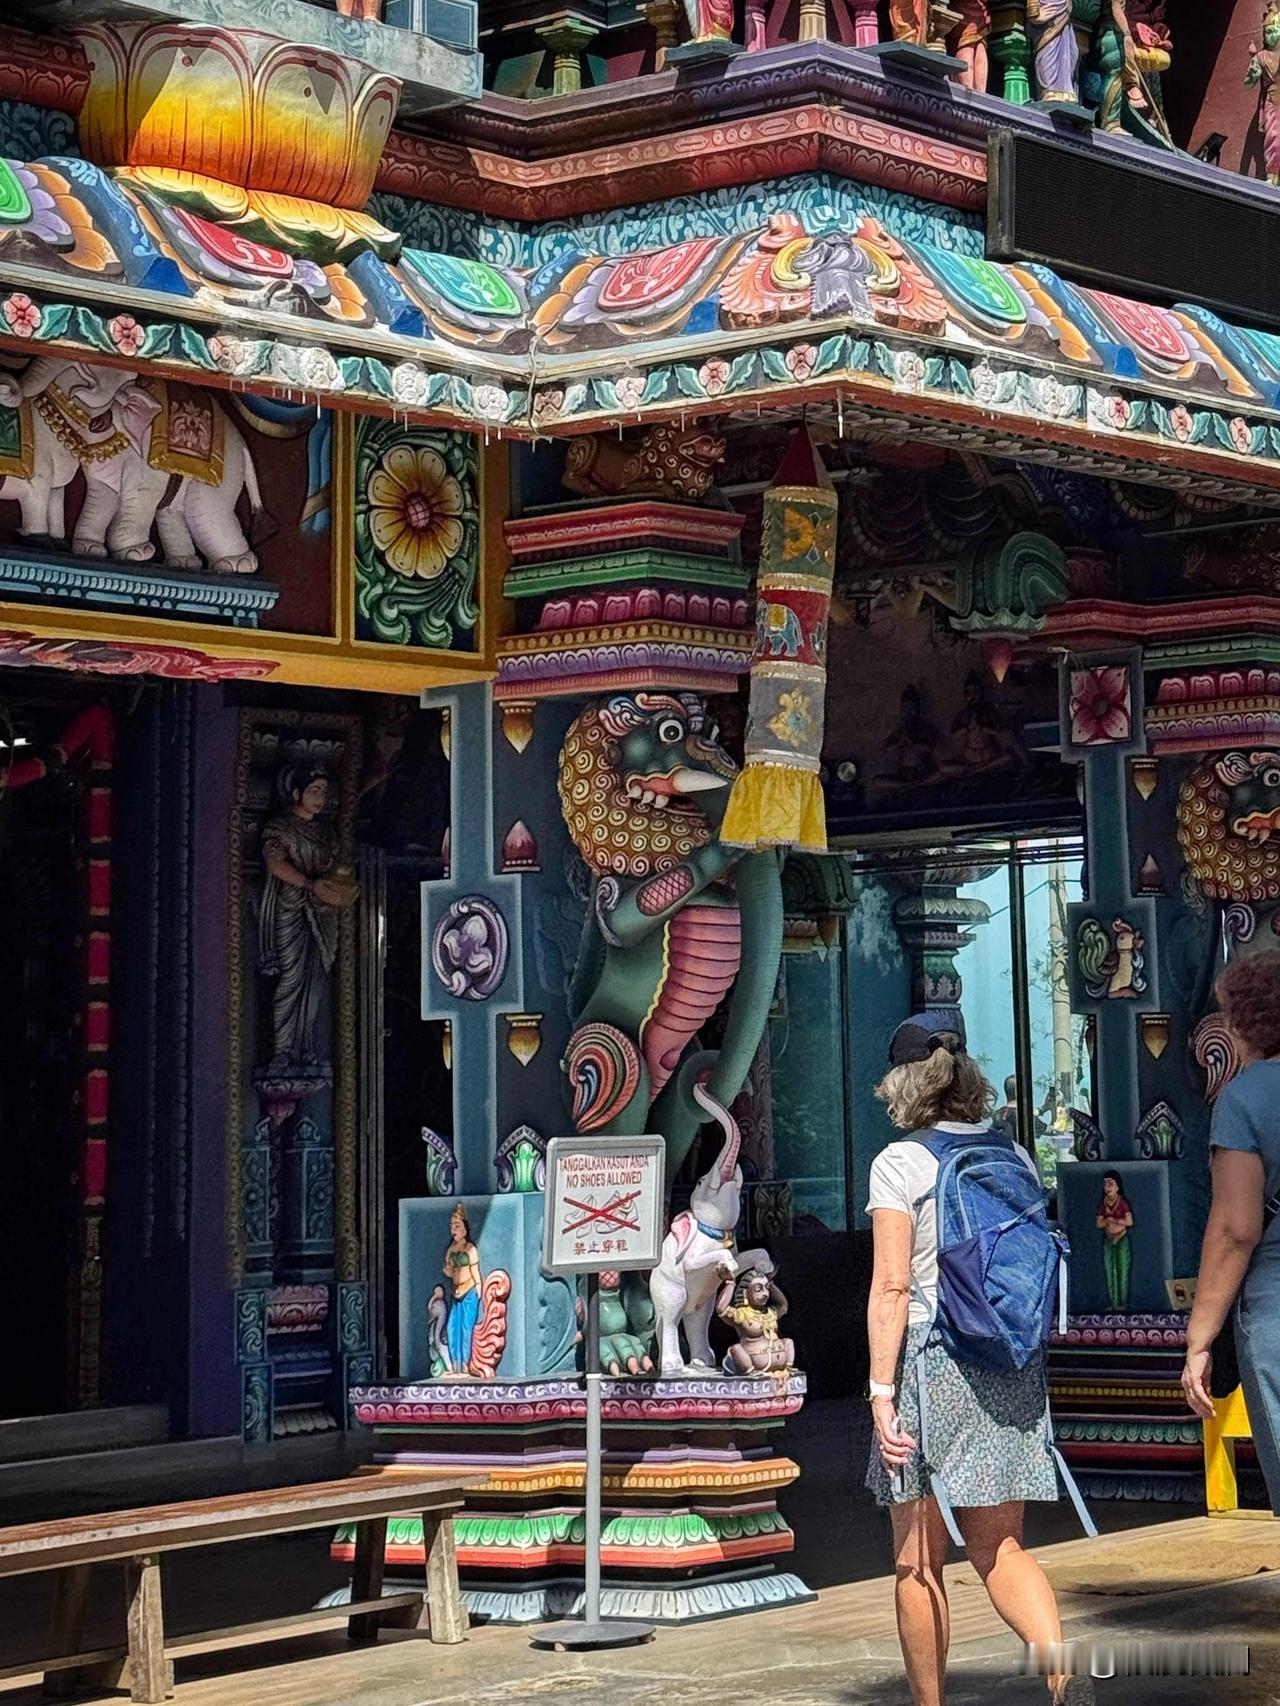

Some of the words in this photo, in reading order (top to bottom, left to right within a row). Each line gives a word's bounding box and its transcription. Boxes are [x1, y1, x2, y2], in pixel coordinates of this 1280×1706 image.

[559, 1157, 606, 1172] TANGGALKAN
[607, 1156, 630, 1169] KASUT
[630, 1155, 649, 1167] ANDA
[566, 1174, 579, 1188] NO
[580, 1172, 606, 1187] SHOES
[607, 1171, 641, 1185] ALLOWED
